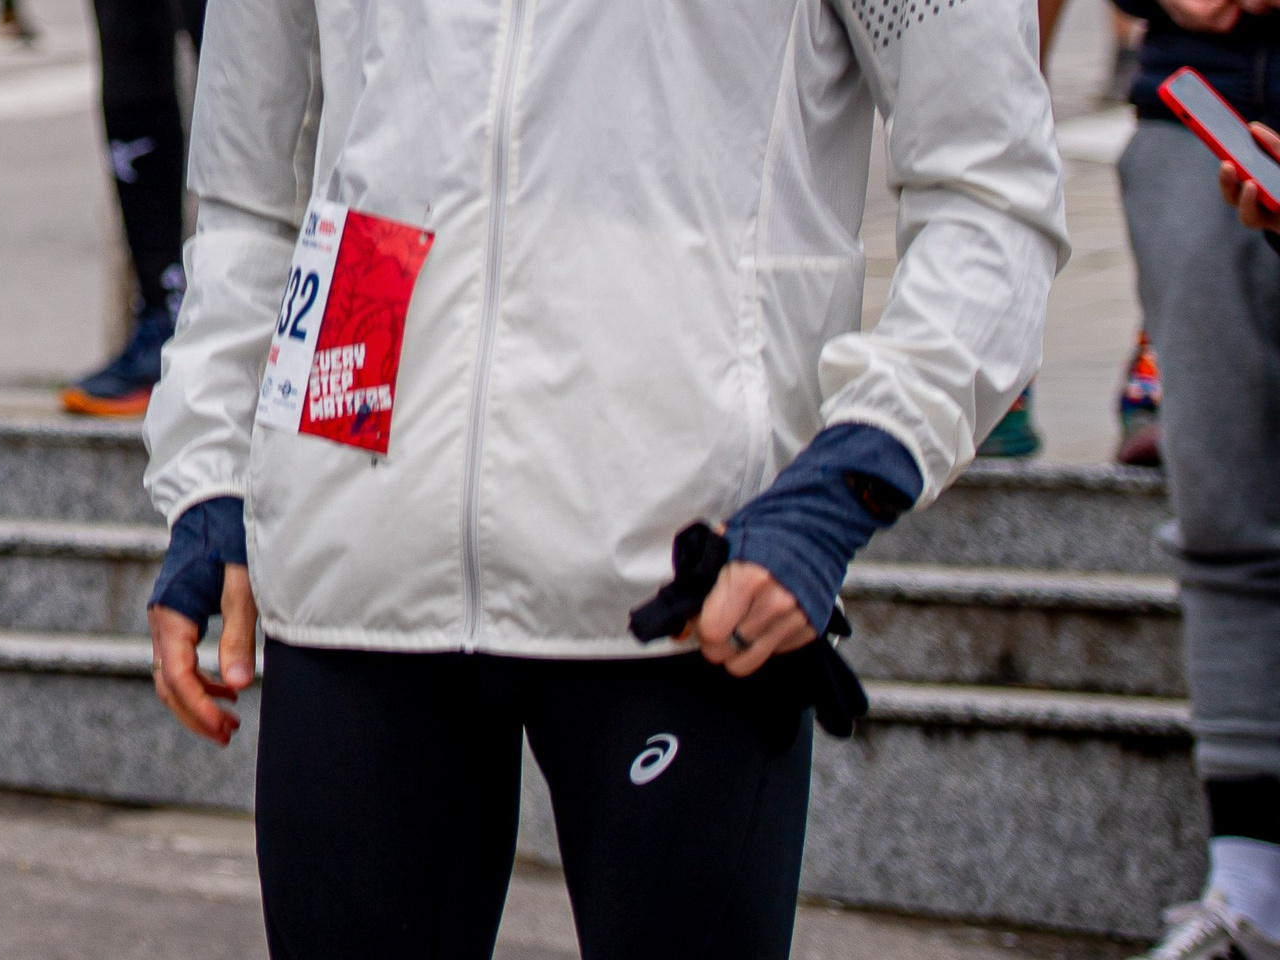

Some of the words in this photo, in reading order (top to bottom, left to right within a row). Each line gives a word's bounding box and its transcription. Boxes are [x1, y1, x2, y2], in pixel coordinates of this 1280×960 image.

[276, 266, 319, 342] 32
[312, 343, 365, 372] EVERY
[309, 370, 353, 398] STEP
[309, 384, 392, 423] MATTERS
